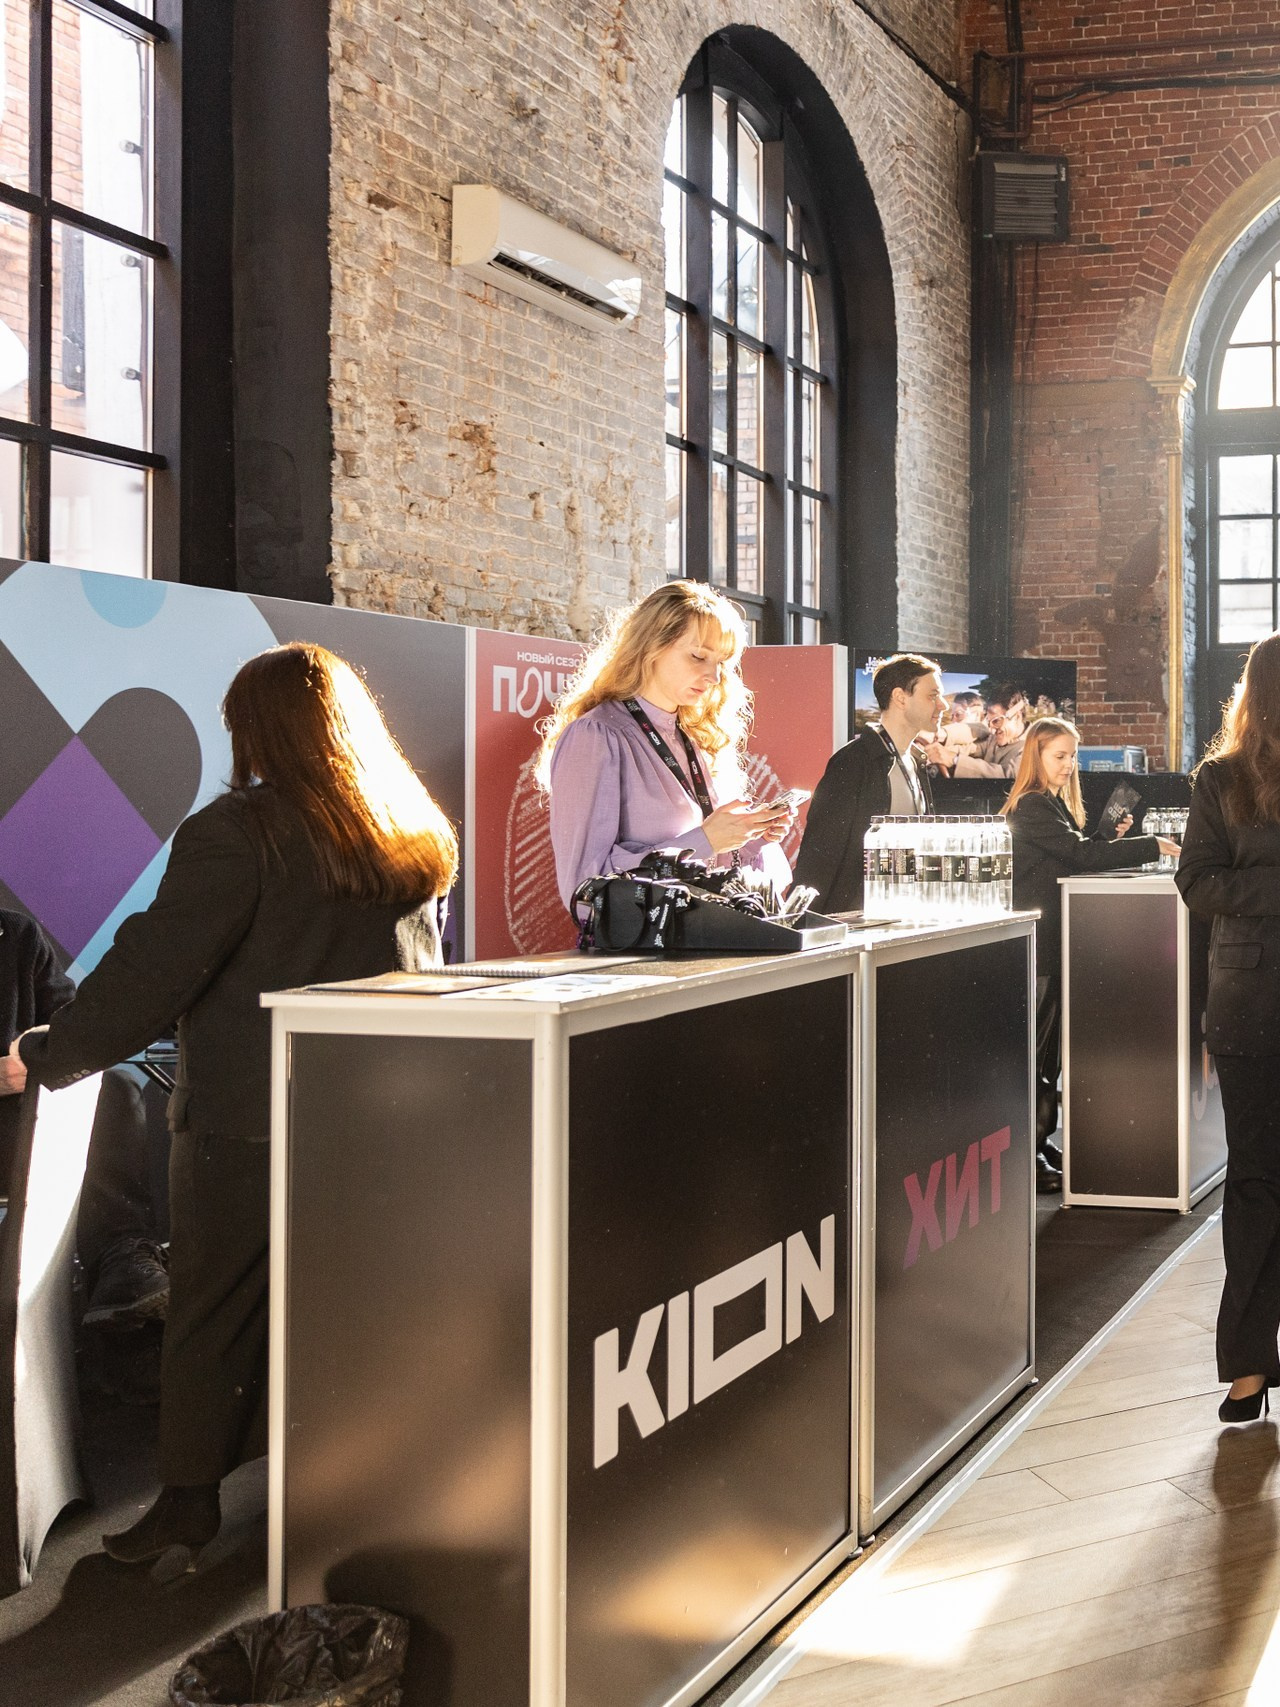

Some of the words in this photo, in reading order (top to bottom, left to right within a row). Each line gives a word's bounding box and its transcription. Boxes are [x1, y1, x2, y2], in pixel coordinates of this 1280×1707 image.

[492, 664, 575, 719] ПОЧ
[517, 651, 554, 665] НОВЫЙ
[555, 656, 583, 668] СЕЗО
[903, 1125, 1011, 1270] ХИТ
[594, 1213, 835, 1469] KION
